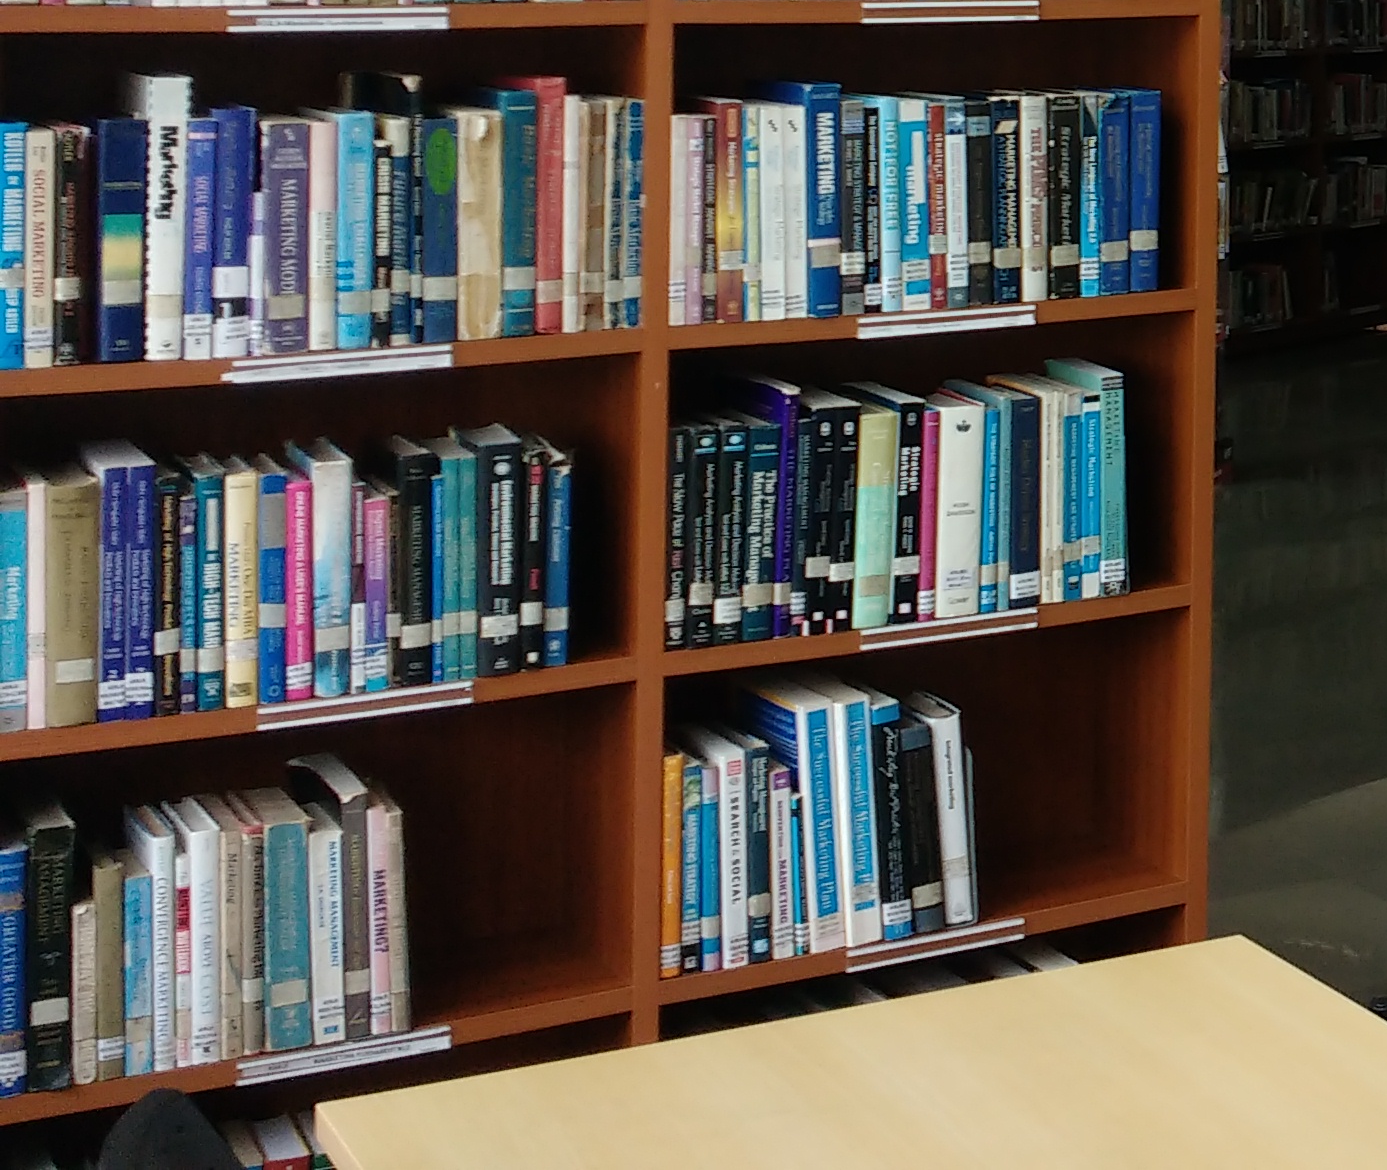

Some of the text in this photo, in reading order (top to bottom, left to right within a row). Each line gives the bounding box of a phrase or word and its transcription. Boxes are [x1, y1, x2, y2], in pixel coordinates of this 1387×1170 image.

[154, 126, 179, 221] Marketing
[815, 112, 835, 195] MARKETING
[884, 121, 897, 230] NOT FOR FREE
[1060, 127, 1072, 189] Strategic
[32, 169, 46, 298] SOCIAL MARKETING
[281, 179, 297, 256] MARKETING
[910, 446, 921, 491] Strategic
[1086, 418, 1097, 497] Strategic Marketing
[1105, 392, 1113, 466] MANAGEMENT
[672, 473, 684, 487] The
[747, 471, 765, 533] Marketing
[898, 446, 909, 496] Marketing
[764, 469, 777, 558] The Practice of
[812, 725, 833, 909] The Successful Marketing Plan
[850, 718, 871, 872] The Successful Marketing
[730, 797, 741, 905] SEARCH SOCIAL
[778, 858, 789, 924] MARKETING
[329, 841, 339, 967] MARKETING MANAGEMENT
[374, 869, 388, 953] MARKETING?
[155, 877, 169, 1042] CONVERGENCE MARKETING
